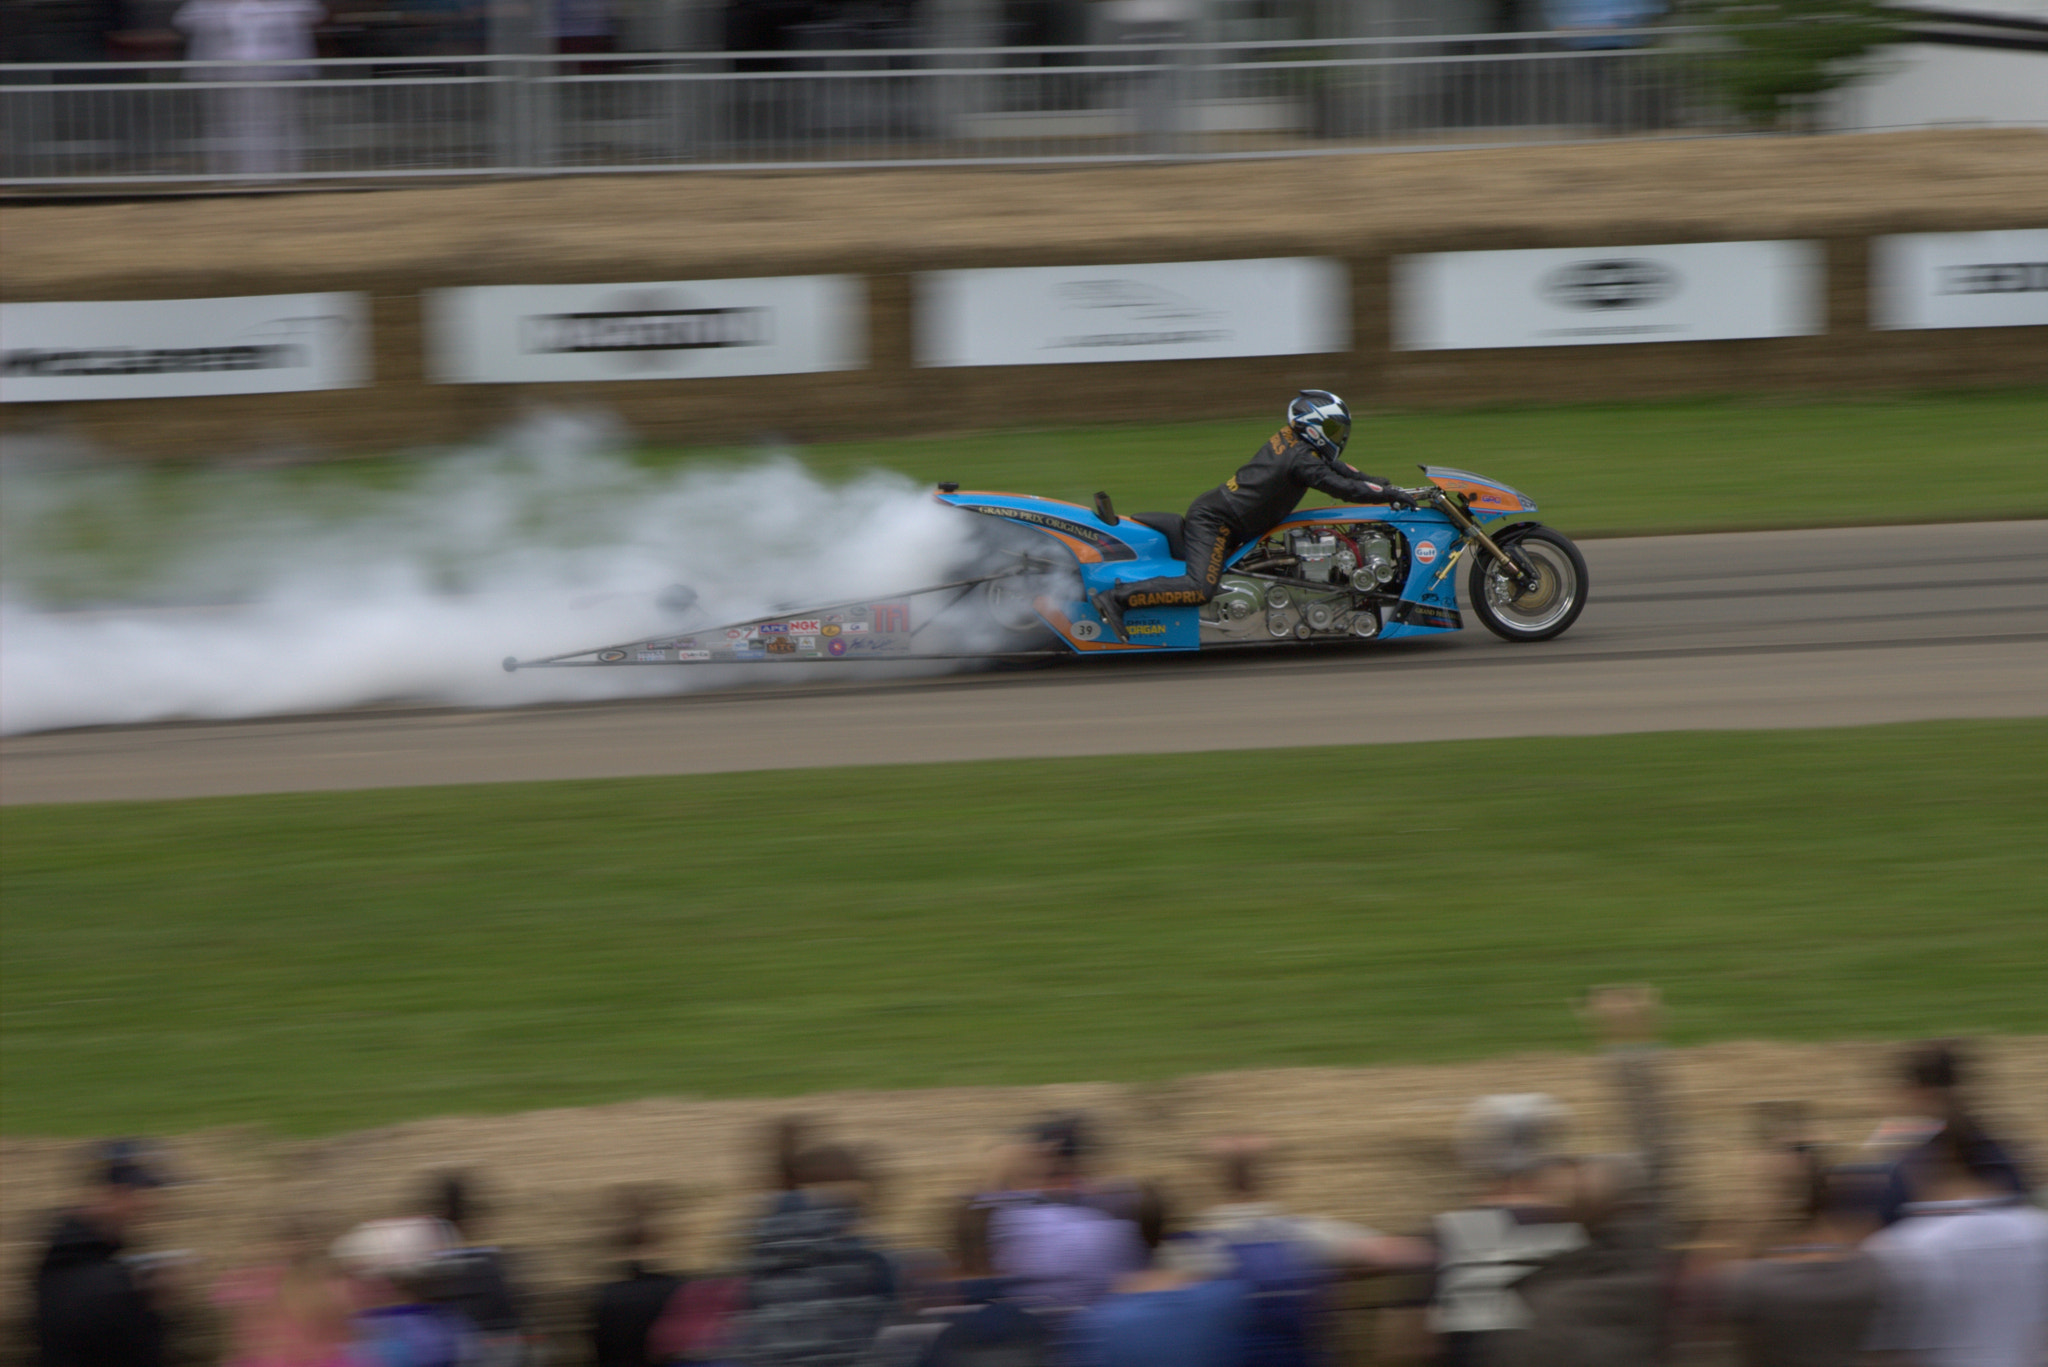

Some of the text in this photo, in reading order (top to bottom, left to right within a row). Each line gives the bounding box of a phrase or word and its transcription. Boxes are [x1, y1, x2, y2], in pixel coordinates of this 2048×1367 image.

[979, 506, 1099, 541] GRAND PRIX ORIGINALS
[762, 624, 787, 632] APE
[790, 621, 819, 631] NGK
[1079, 625, 1093, 636] 39
